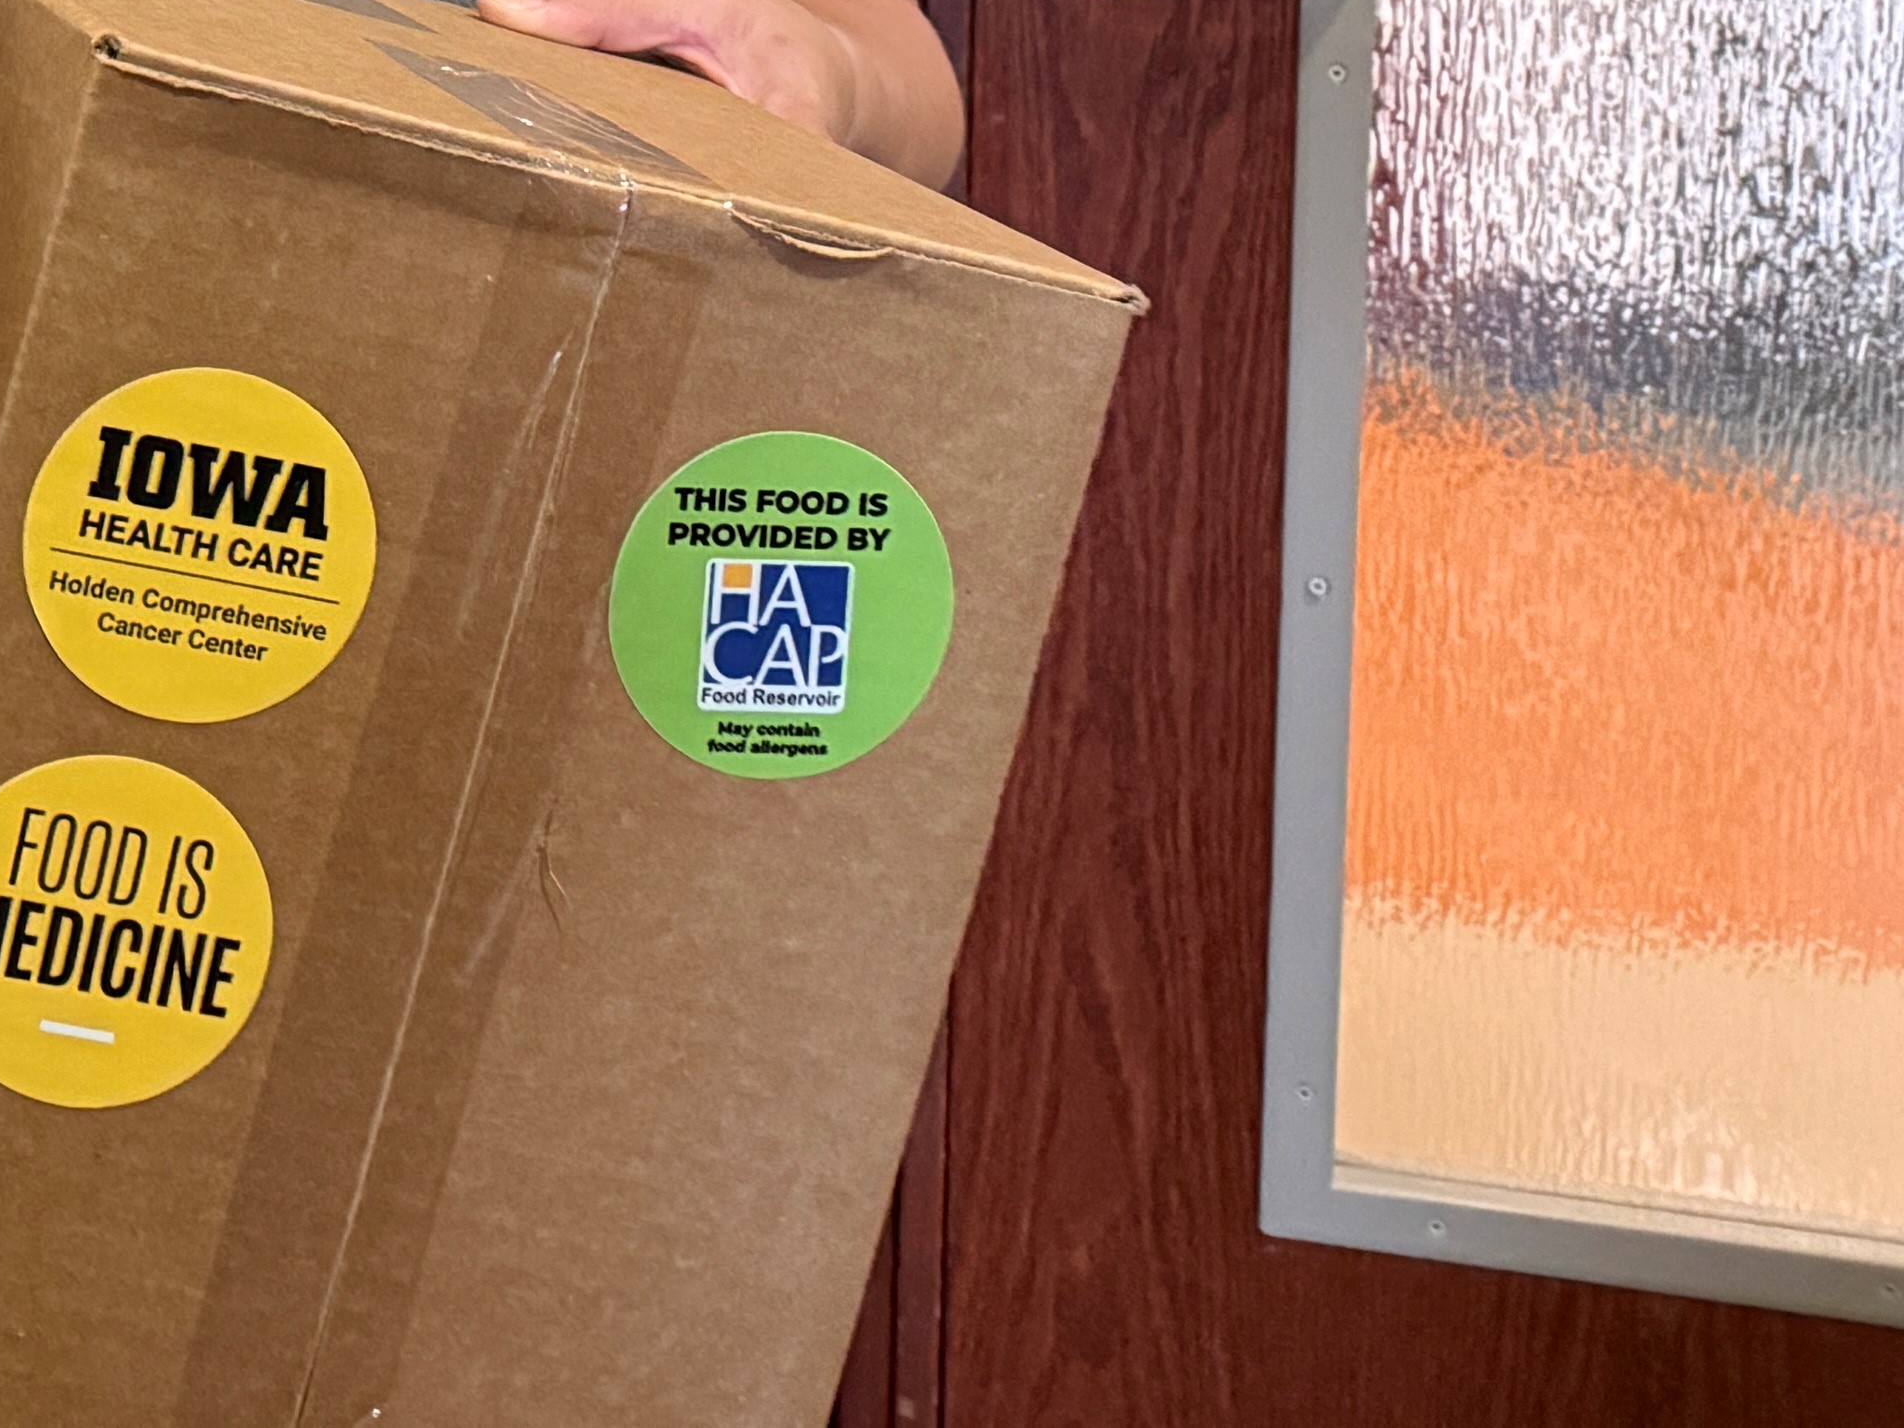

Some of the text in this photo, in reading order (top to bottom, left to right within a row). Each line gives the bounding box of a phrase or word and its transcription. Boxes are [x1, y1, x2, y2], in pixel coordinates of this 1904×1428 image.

[87, 425, 330, 541] IOWA
[674, 487, 888, 517] THIS FOOD IS
[79, 508, 324, 582] HEALTH CARE
[667, 522, 892, 552] PROVIDED BY
[48, 570, 327, 641] Holden Comprehensive
[97, 612, 269, 662] Cancer Center
[701, 687, 841, 707] Food Reservoir
[707, 739, 828, 757] food allergens
[718, 721, 821, 739] May contain
[9, 807, 214, 920] FOOD IS
